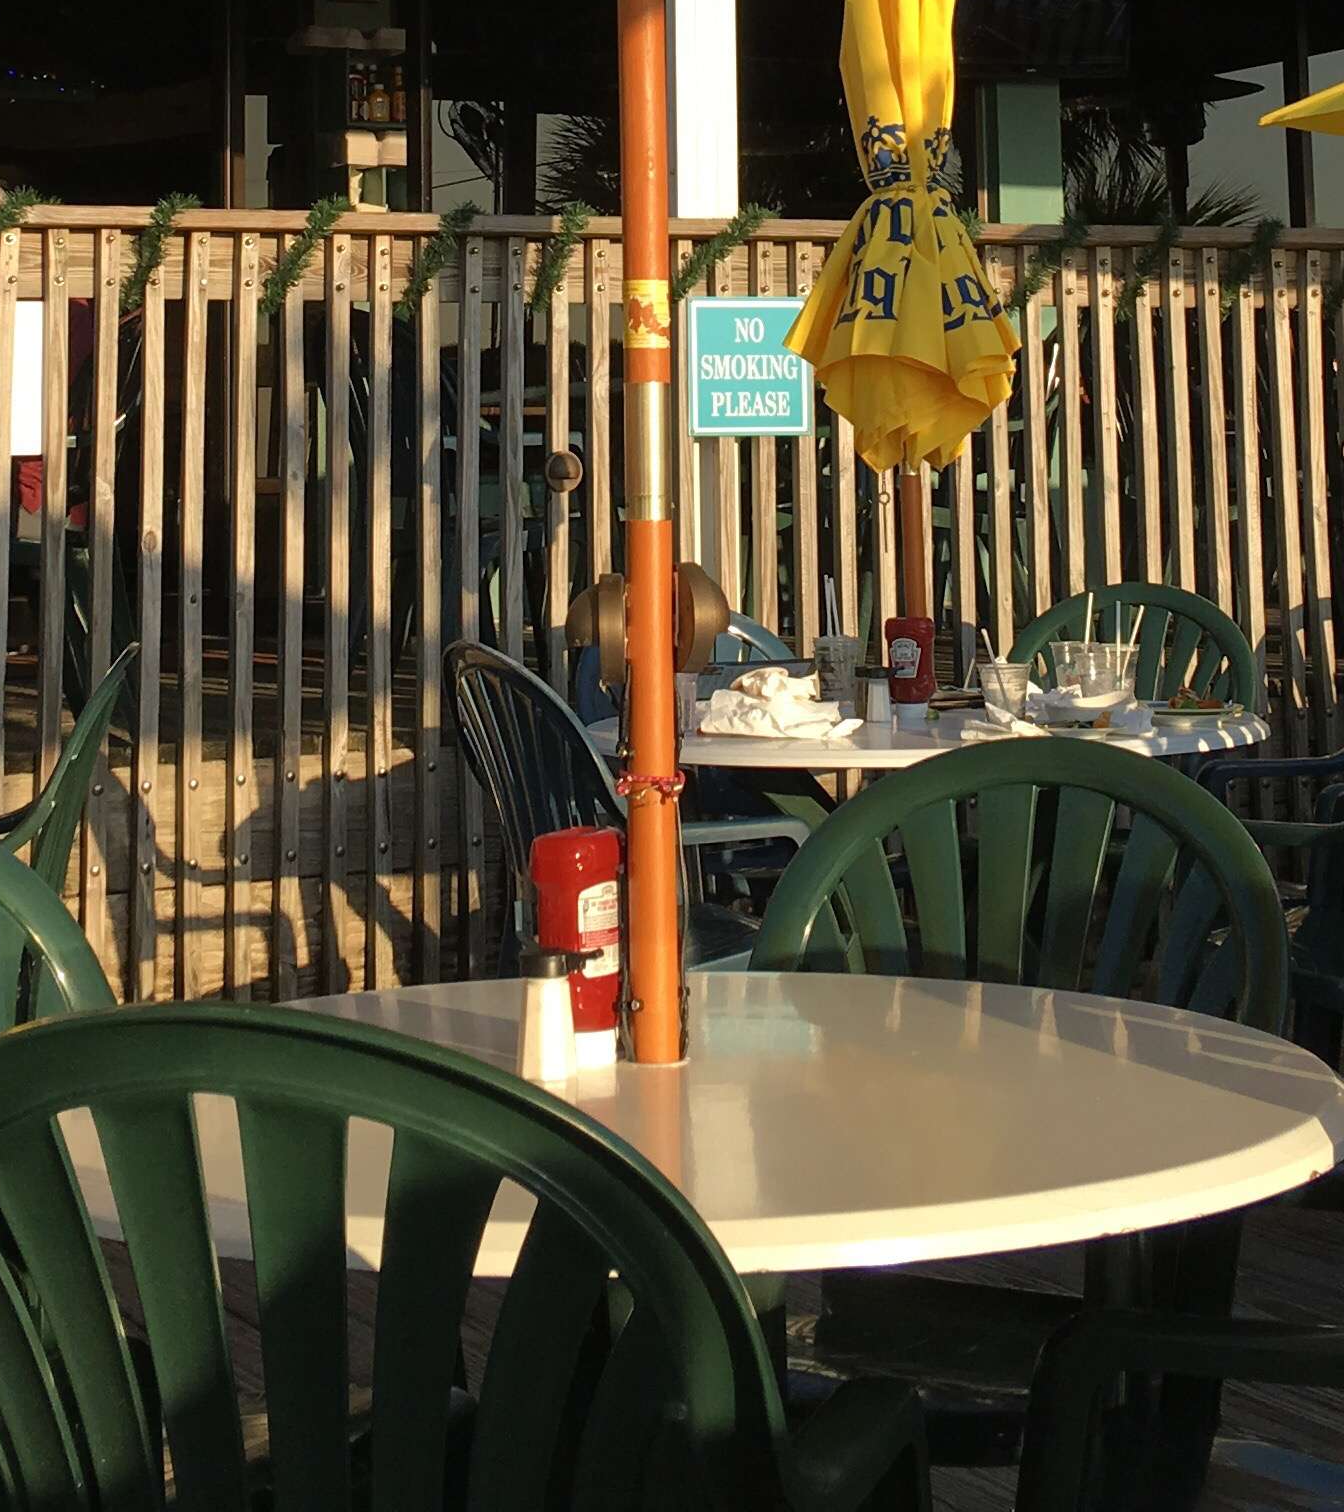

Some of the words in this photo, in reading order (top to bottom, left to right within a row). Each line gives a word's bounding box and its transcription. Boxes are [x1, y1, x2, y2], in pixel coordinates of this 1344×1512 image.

[734, 317, 765, 343] NO
[700, 354, 798, 381] SMOKING
[711, 391, 790, 417] PLEASE
